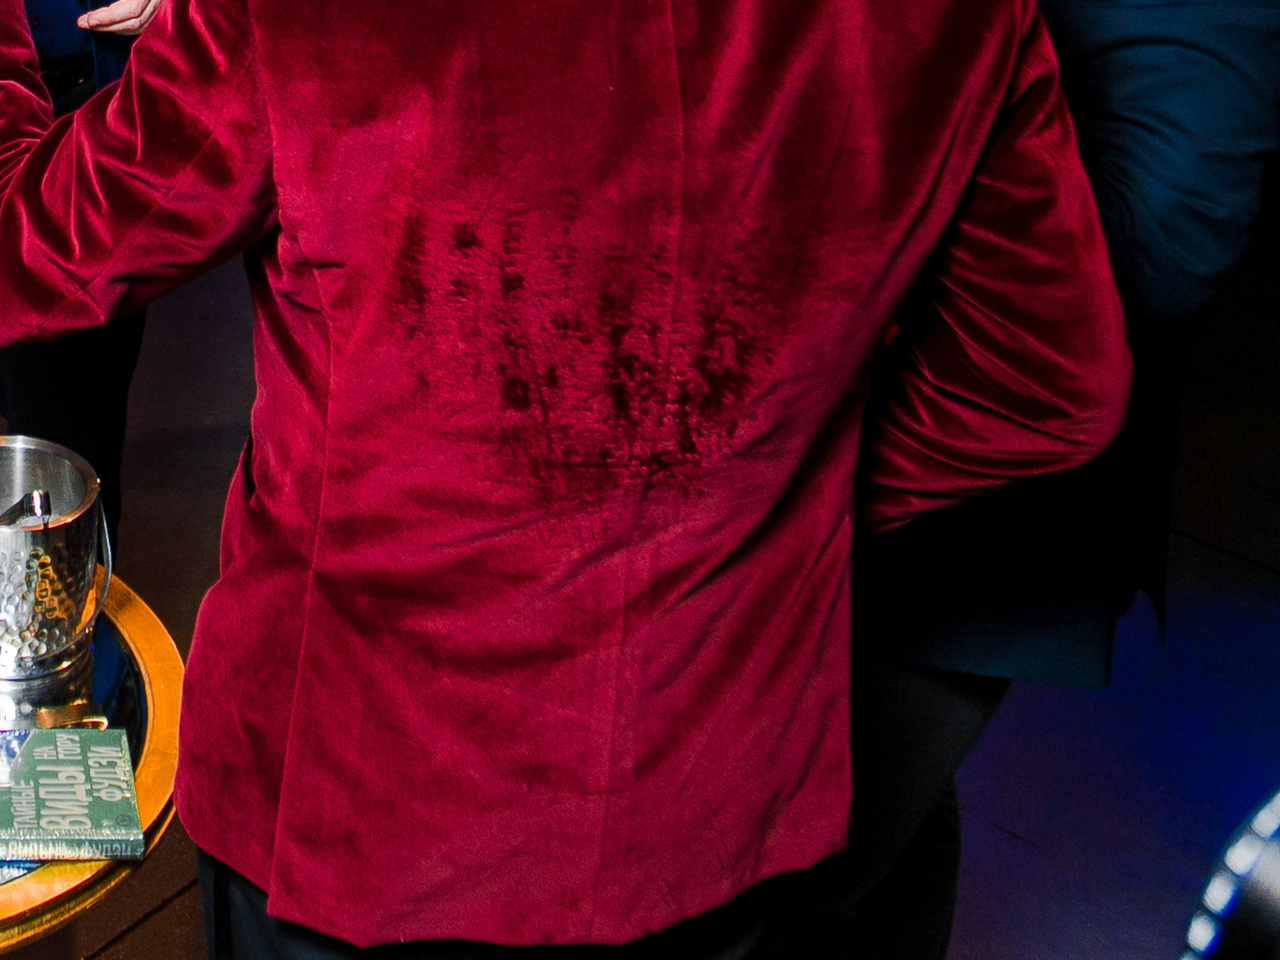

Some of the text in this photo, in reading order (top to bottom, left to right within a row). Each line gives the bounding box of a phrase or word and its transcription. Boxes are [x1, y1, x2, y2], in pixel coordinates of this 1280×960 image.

[32, 746, 57, 760] НА
[55, 733, 82, 760] ГОРУ
[36, 766, 93, 830] ВИДЫ
[87, 746, 128, 802] ФУДЗИ
[10, 779, 38, 830] ТАЙНЫЕ
